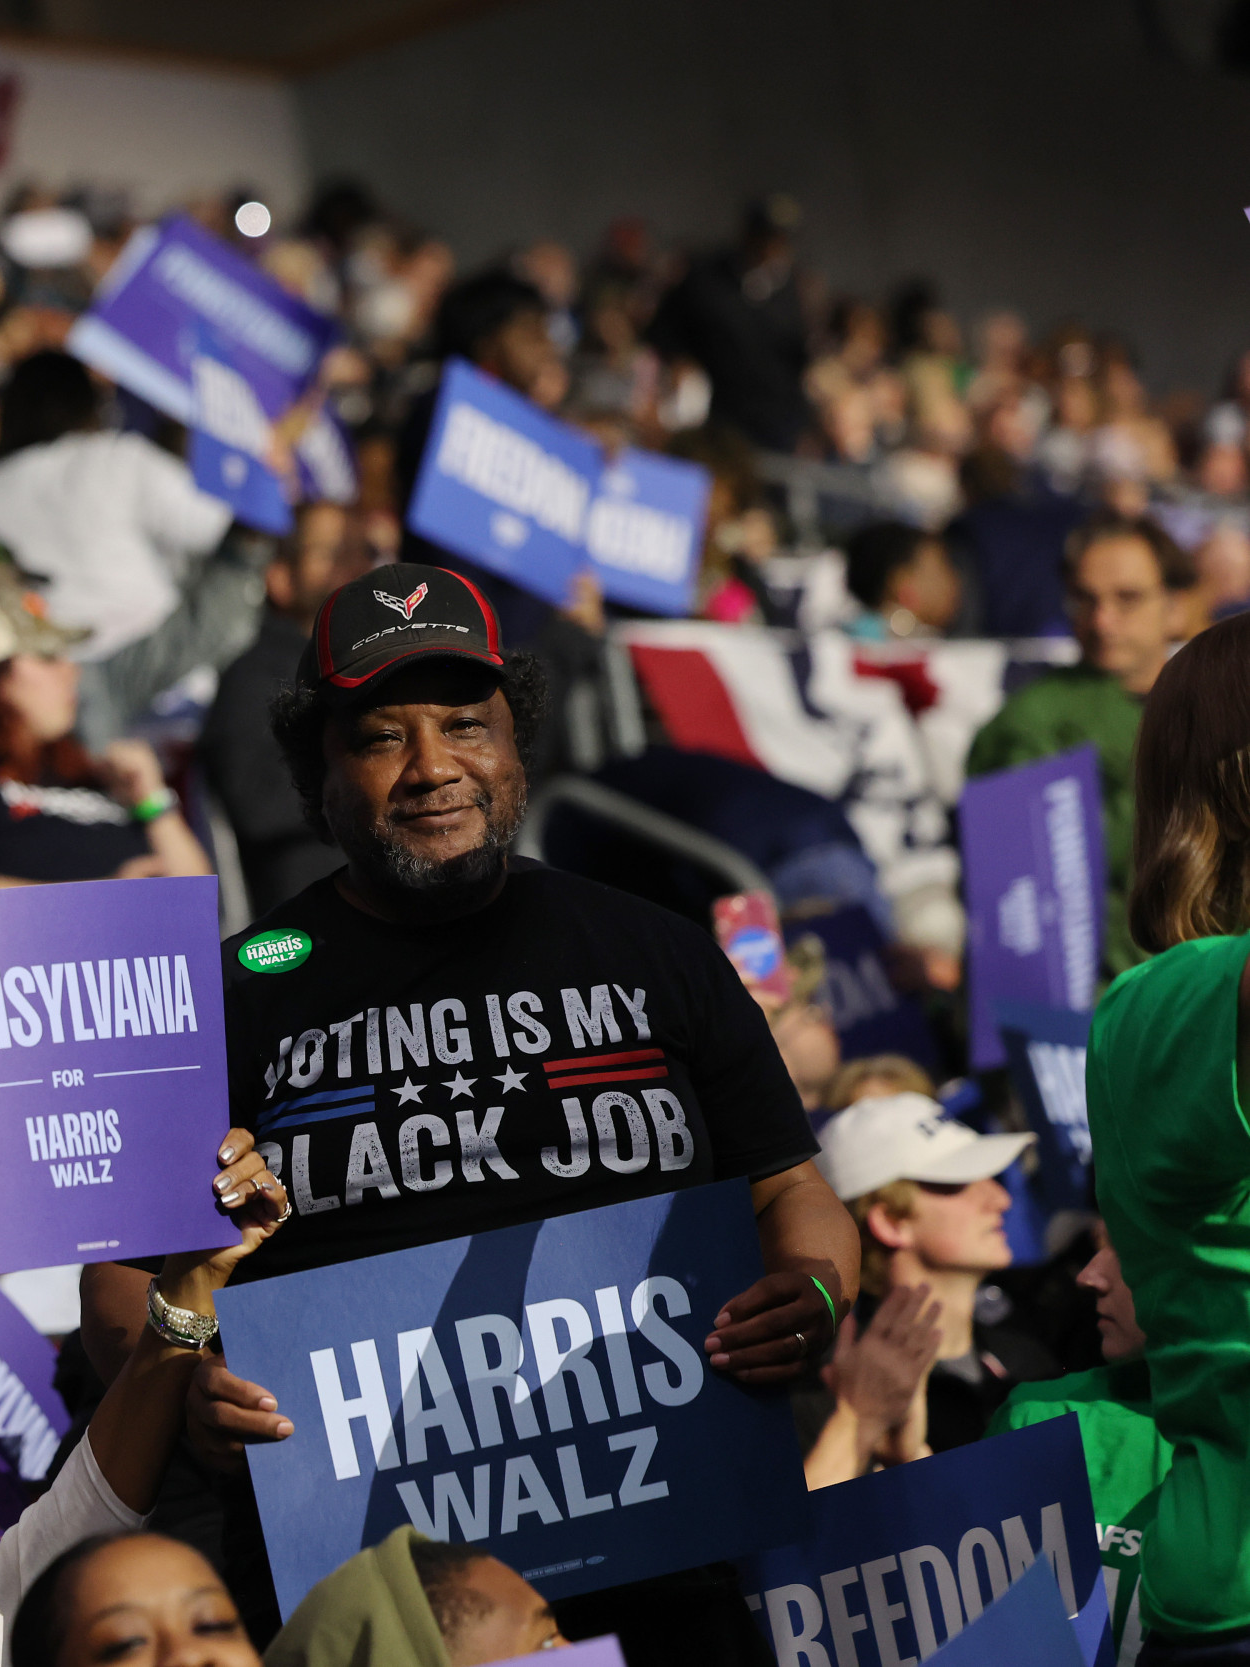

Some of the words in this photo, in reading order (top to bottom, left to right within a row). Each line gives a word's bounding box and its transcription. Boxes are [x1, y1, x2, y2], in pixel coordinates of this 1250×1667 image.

[351, 622, 470, 651] CORVETTE
[246, 937, 303, 961] HARRIS
[258, 951, 297, 966] WALZ
[263, 998, 474, 1100] VOTING
[485, 990, 551, 1058] IS
[560, 984, 652, 1049] MY
[52, 1068, 85, 1089] FOR
[25, 1108, 123, 1162] HARRIS
[540, 1088, 695, 1178] JOB
[50, 1158, 114, 1189] WALZ
[309, 1275, 704, 1481] HARRIS
[395, 1425, 670, 1543] WALZ
[745, 1502, 1080, 1667] REEDOM
